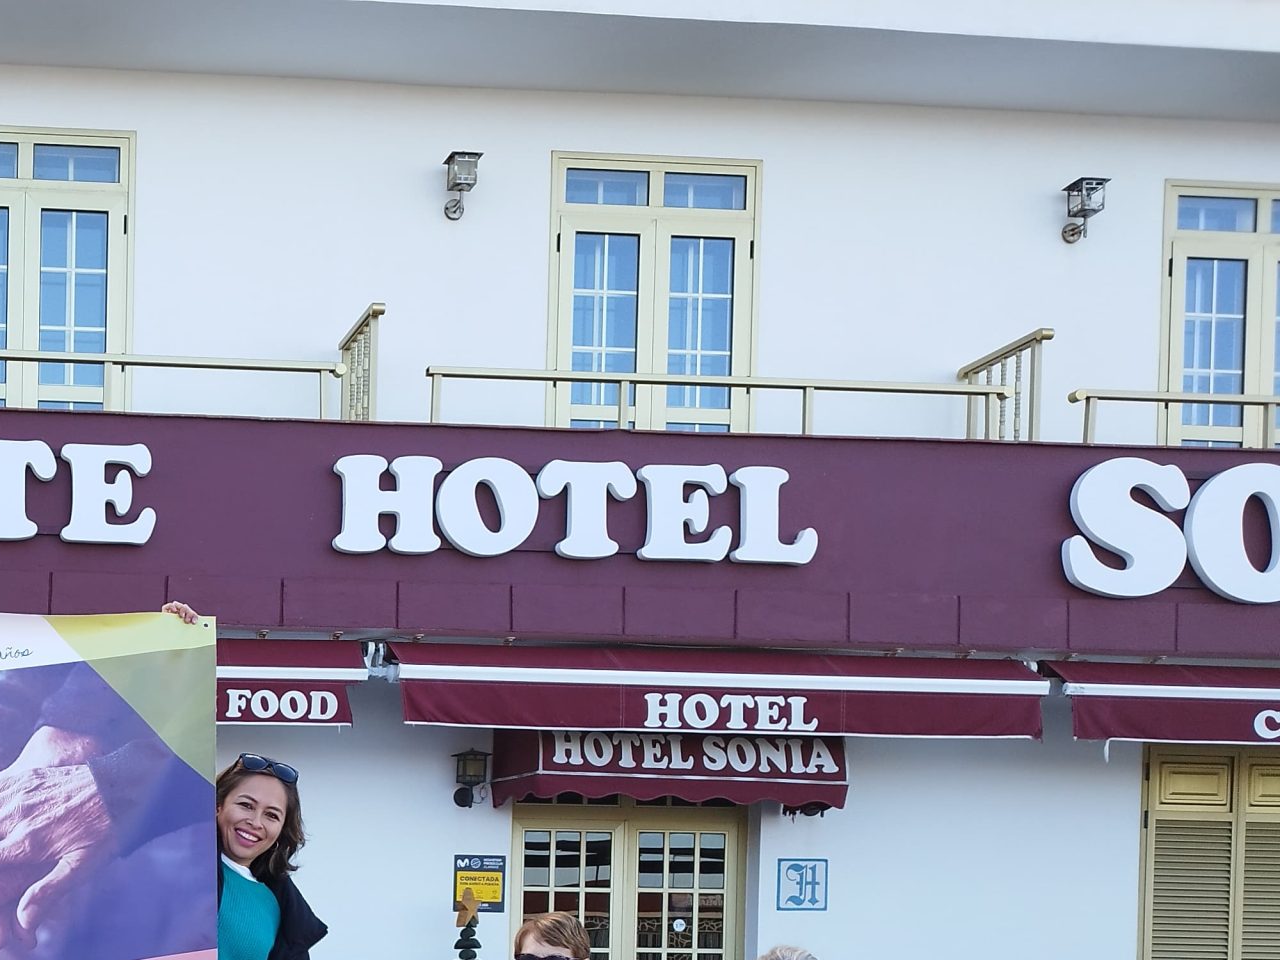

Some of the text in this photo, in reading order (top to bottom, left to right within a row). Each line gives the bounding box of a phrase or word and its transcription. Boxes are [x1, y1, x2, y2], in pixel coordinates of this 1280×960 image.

[330, 453, 819, 567] HOTEL
[225, 689, 339, 720] FOOD
[644, 692, 819, 733] HOTEL
[552, 730, 840, 774] HOTEL SONIA
